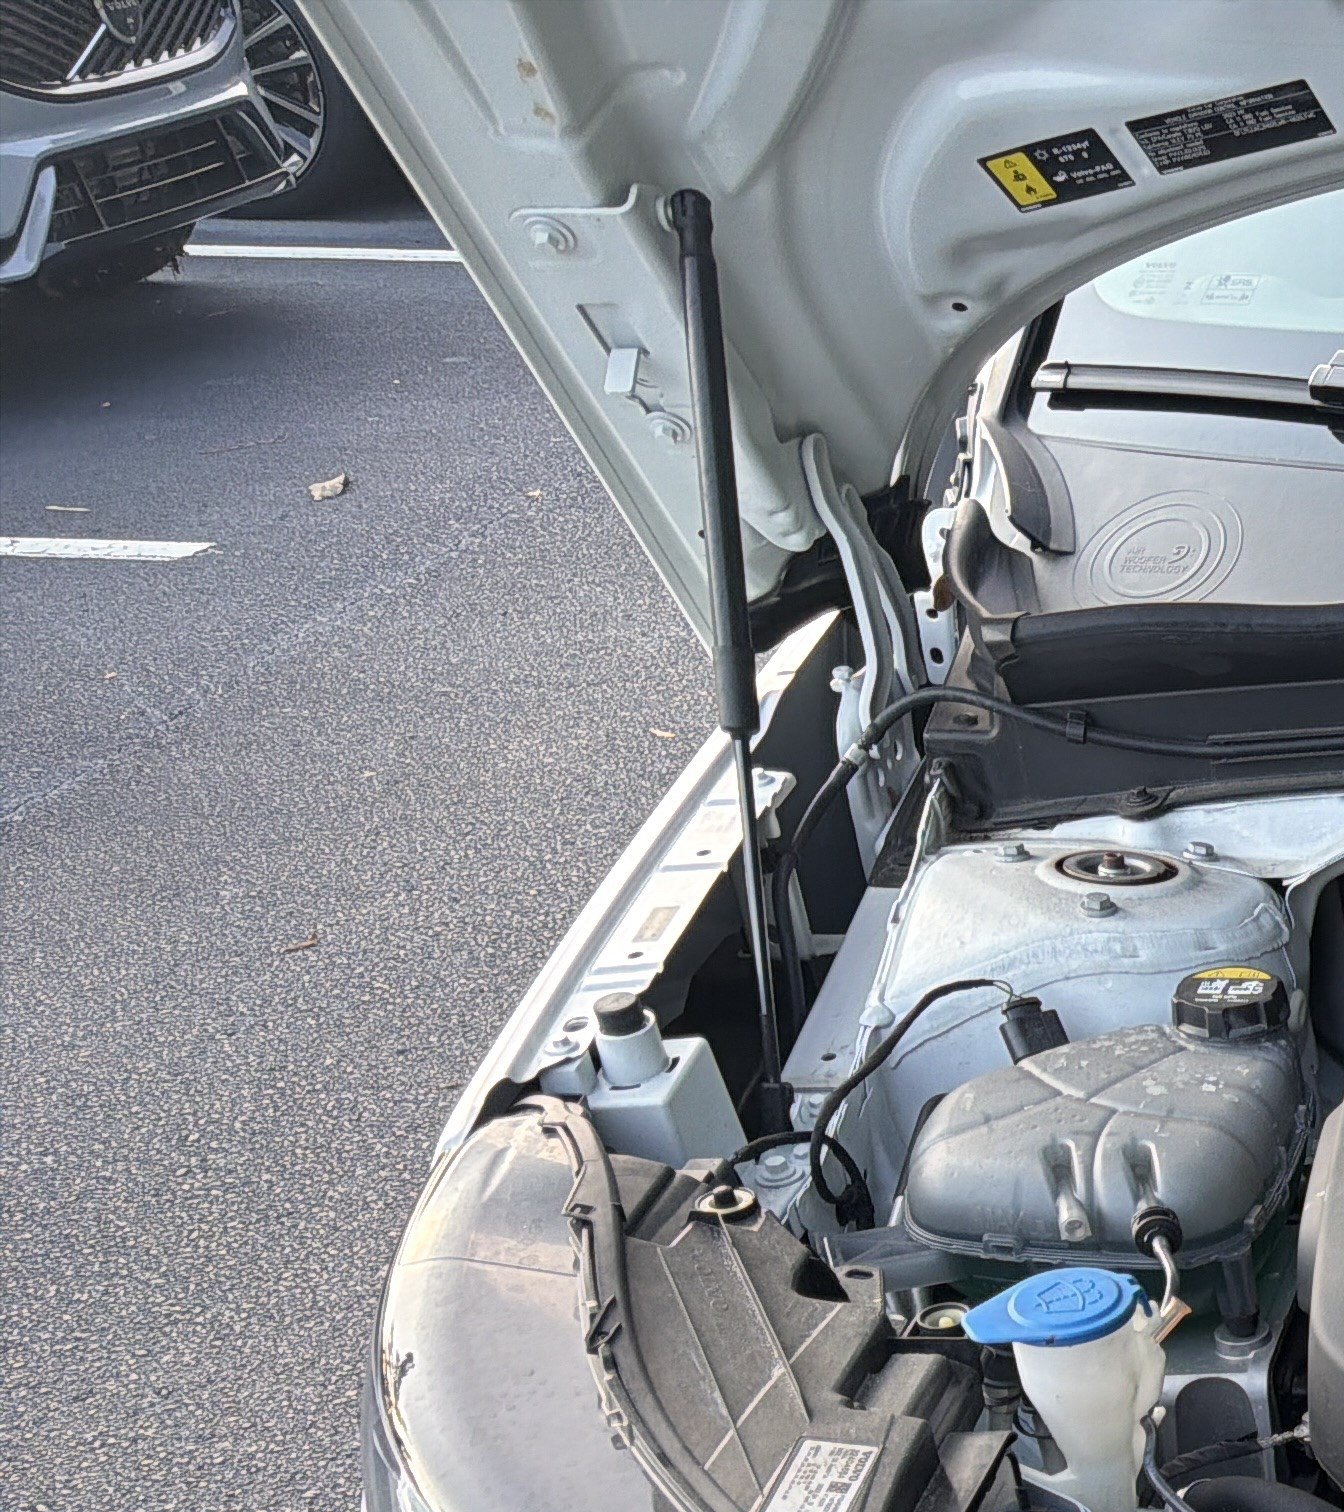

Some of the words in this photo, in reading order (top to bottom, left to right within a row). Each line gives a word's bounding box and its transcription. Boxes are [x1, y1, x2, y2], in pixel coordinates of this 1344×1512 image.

[1123, 556, 1166, 565] WOOFER
[1119, 565, 1189, 574] TECHNOLOGY
[848, 1450, 874, 1482] VOLVO
